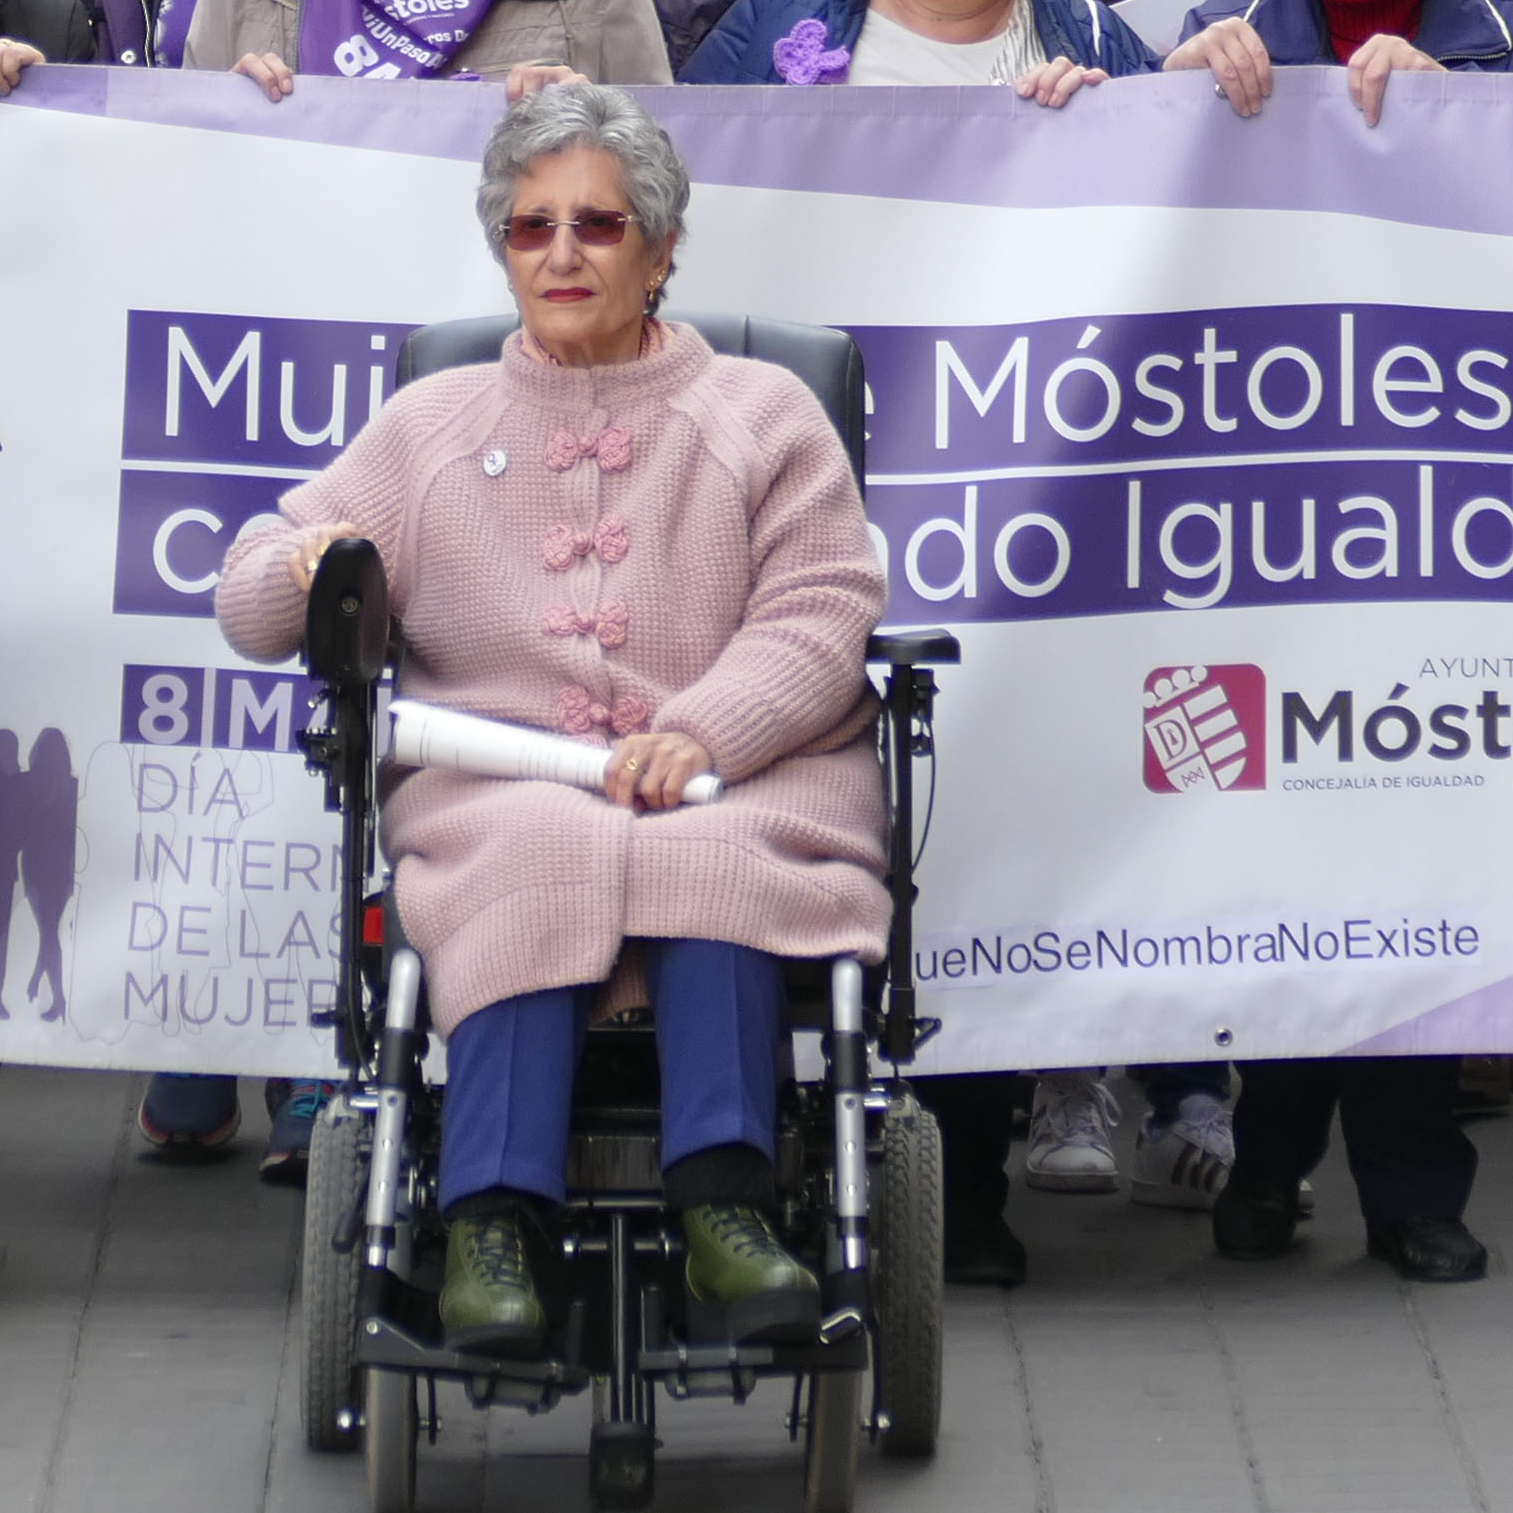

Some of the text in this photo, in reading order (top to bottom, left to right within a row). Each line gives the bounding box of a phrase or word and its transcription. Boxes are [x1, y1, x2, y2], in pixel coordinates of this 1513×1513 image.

[935, 313, 1513, 450] Móstoles
[138, 673, 188, 746] 8
[137, 751, 245, 819] DÍA
[1282, 774, 1486, 791] CONCEJALÍA DE IGUALDAD
[128, 901, 212, 957] DE
[915, 917, 1480, 983] ueNoSeNombraNoExiste
